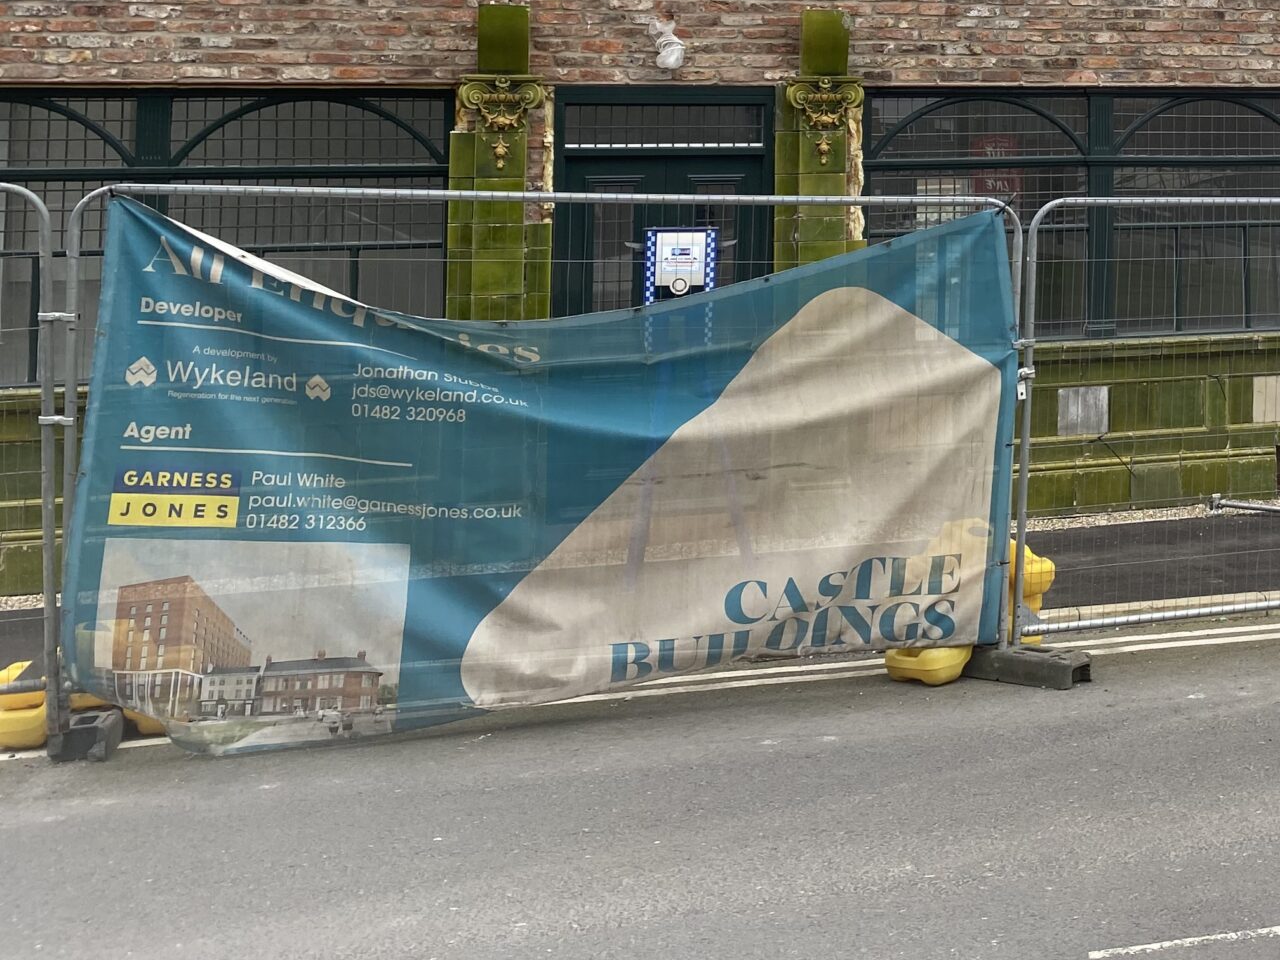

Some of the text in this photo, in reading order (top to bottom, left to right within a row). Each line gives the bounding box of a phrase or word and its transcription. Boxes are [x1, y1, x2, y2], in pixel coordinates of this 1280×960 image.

[142, 236, 226, 285] All
[140, 296, 243, 324] Developer
[192, 345, 279, 364] A development by
[166, 360, 297, 392] Wykeland
[353, 363, 500, 393] Jonathan Stubbs
[167, 390, 298, 406] Regeneration for the next generation
[351, 383, 529, 408] jds@wykeland.co.uk
[351, 403, 467, 423] 01482 320968
[123, 421, 193, 443] Agent
[123, 470, 233, 488] GARNESS
[251, 470, 347, 489] Paul White
[119, 501, 230, 519] JONES
[248, 493, 523, 520] paul.white@garnessjones.co.uk
[245, 513, 368, 532] 01482 312366
[723, 553, 963, 625] CASTLE
[609, 598, 957, 684] BUILDINGS
